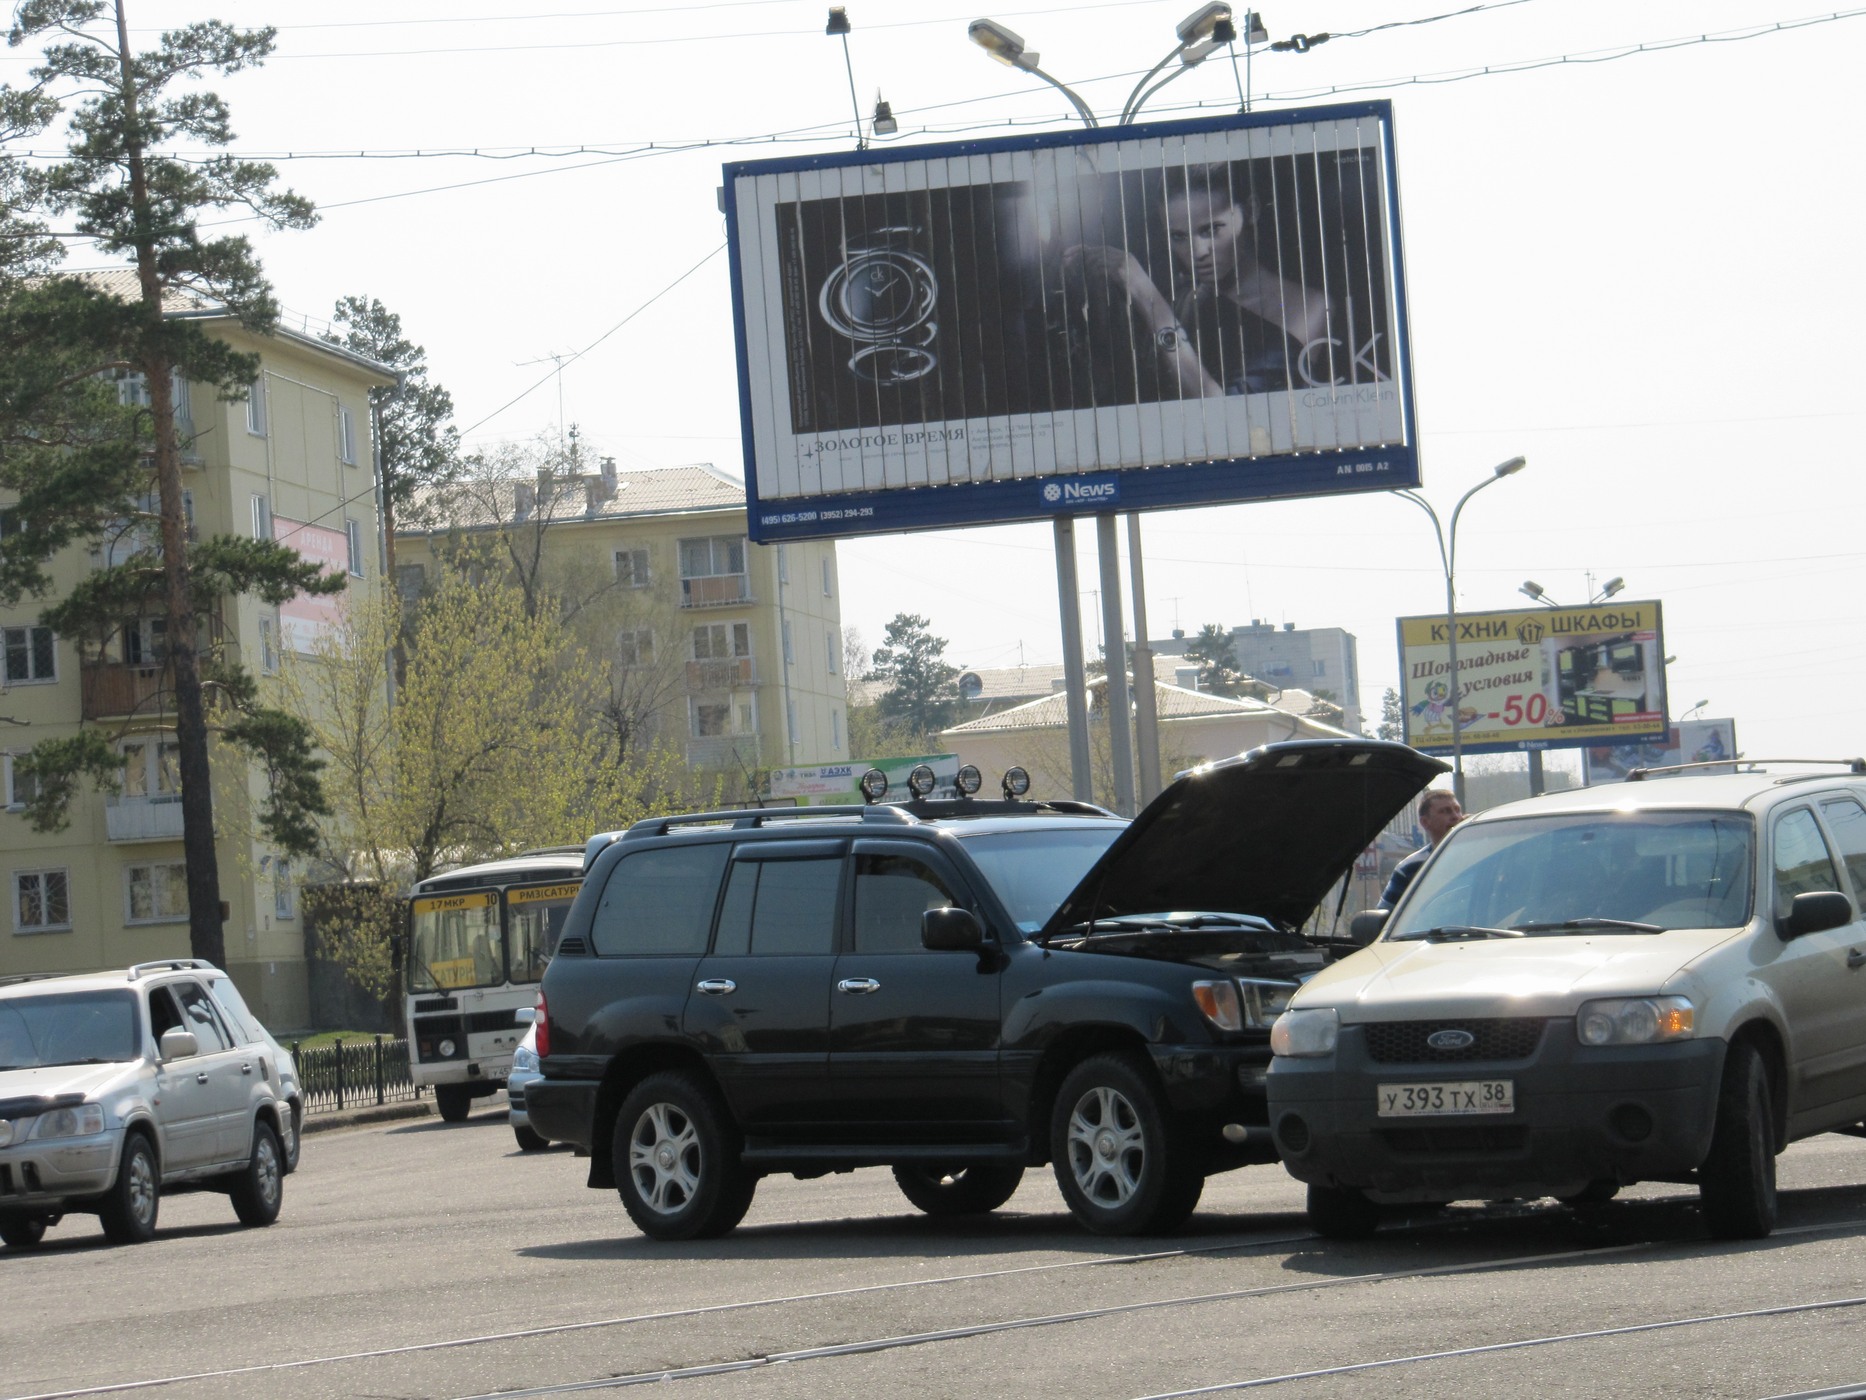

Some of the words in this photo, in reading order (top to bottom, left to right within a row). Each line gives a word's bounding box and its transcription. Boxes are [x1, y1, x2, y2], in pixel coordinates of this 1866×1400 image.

[1302, 391, 1352, 409] Calvin
[1355, 387, 1394, 403] Klein
[814, 433, 899, 453] ЗОЛОТОЕ
[902, 428, 965, 446] ВРЕМЯ
[1336, 464, 1353, 475] AN
[1376, 461, 1390, 472] A2
[1064, 482, 1116, 499] News
[761, 515, 781, 526] (495)
[781, 511, 818, 523] 626-5200
[820, 510, 843, 521] (3952)
[844, 507, 874, 518] 294-293
[1551, 611, 1641, 633] ШКАФЫ
[828, 765, 852, 777] АЭХК
[484, 893, 498, 906] 10
[433, 966, 475, 985] САТУРН
[1437, 1033, 1463, 1046] Ford
[1482, 1083, 1506, 1101] 38
